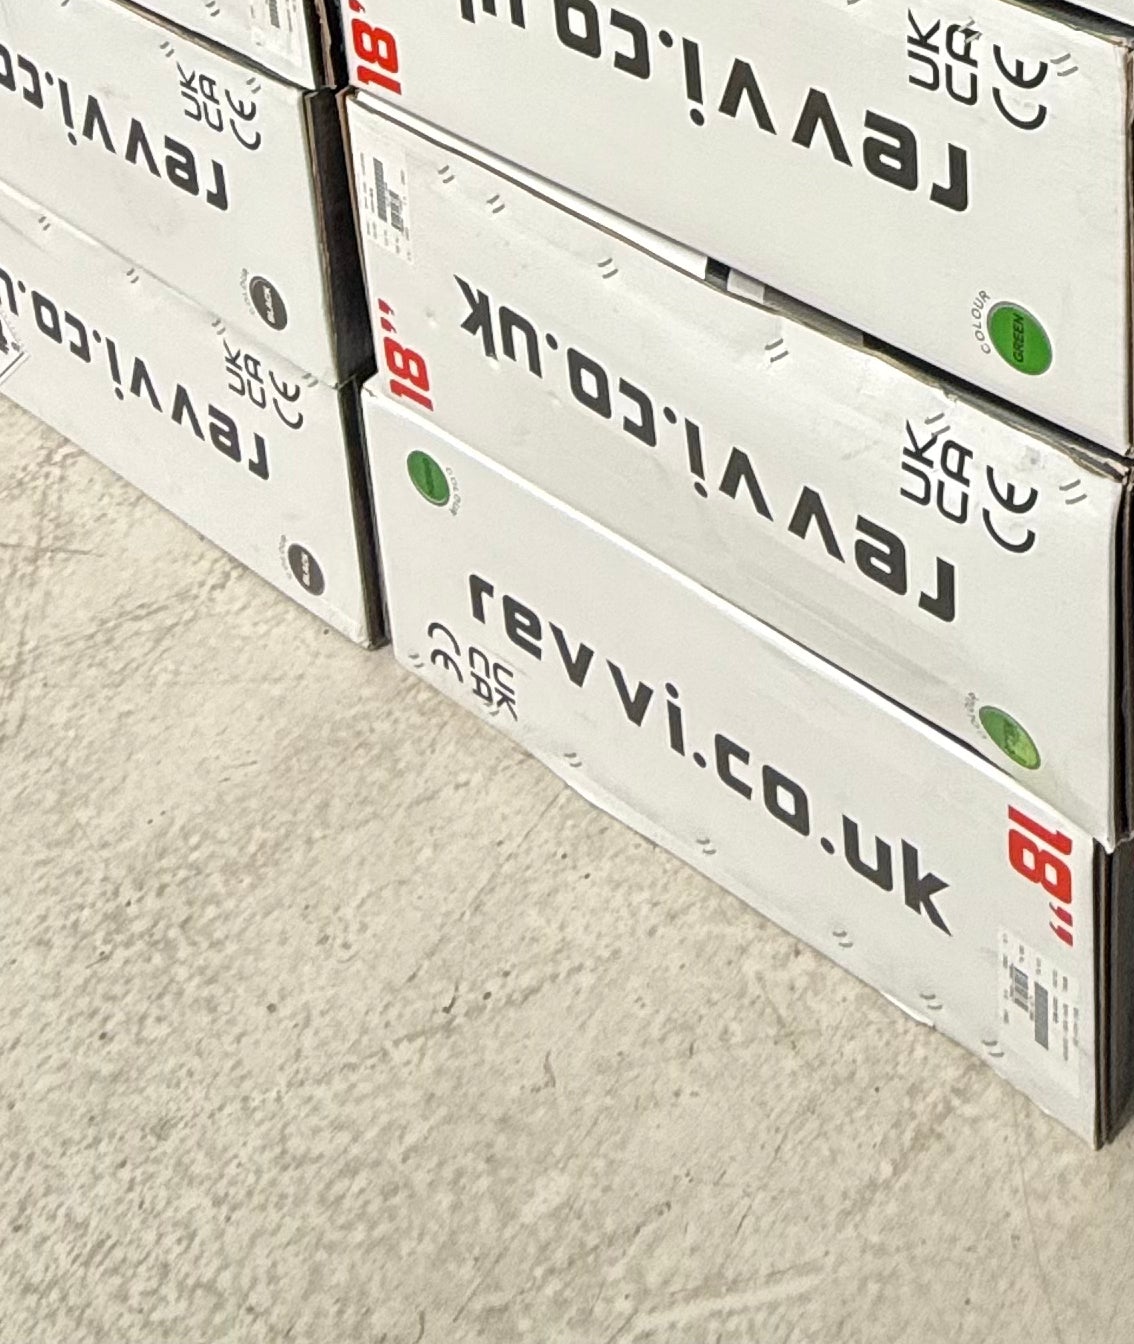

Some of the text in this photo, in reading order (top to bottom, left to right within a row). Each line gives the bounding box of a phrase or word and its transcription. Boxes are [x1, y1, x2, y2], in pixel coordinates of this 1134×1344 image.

[0, 39, 228, 211] revvi.c
[0, 265, 270, 481] revvi.co.u
[976, 292, 990, 356] COLOUR
[1011, 313, 1026, 362] GREEN
[454, 275, 956, 623] revvi.co.uk
[469, 574, 953, 936] revvi.co.uk
